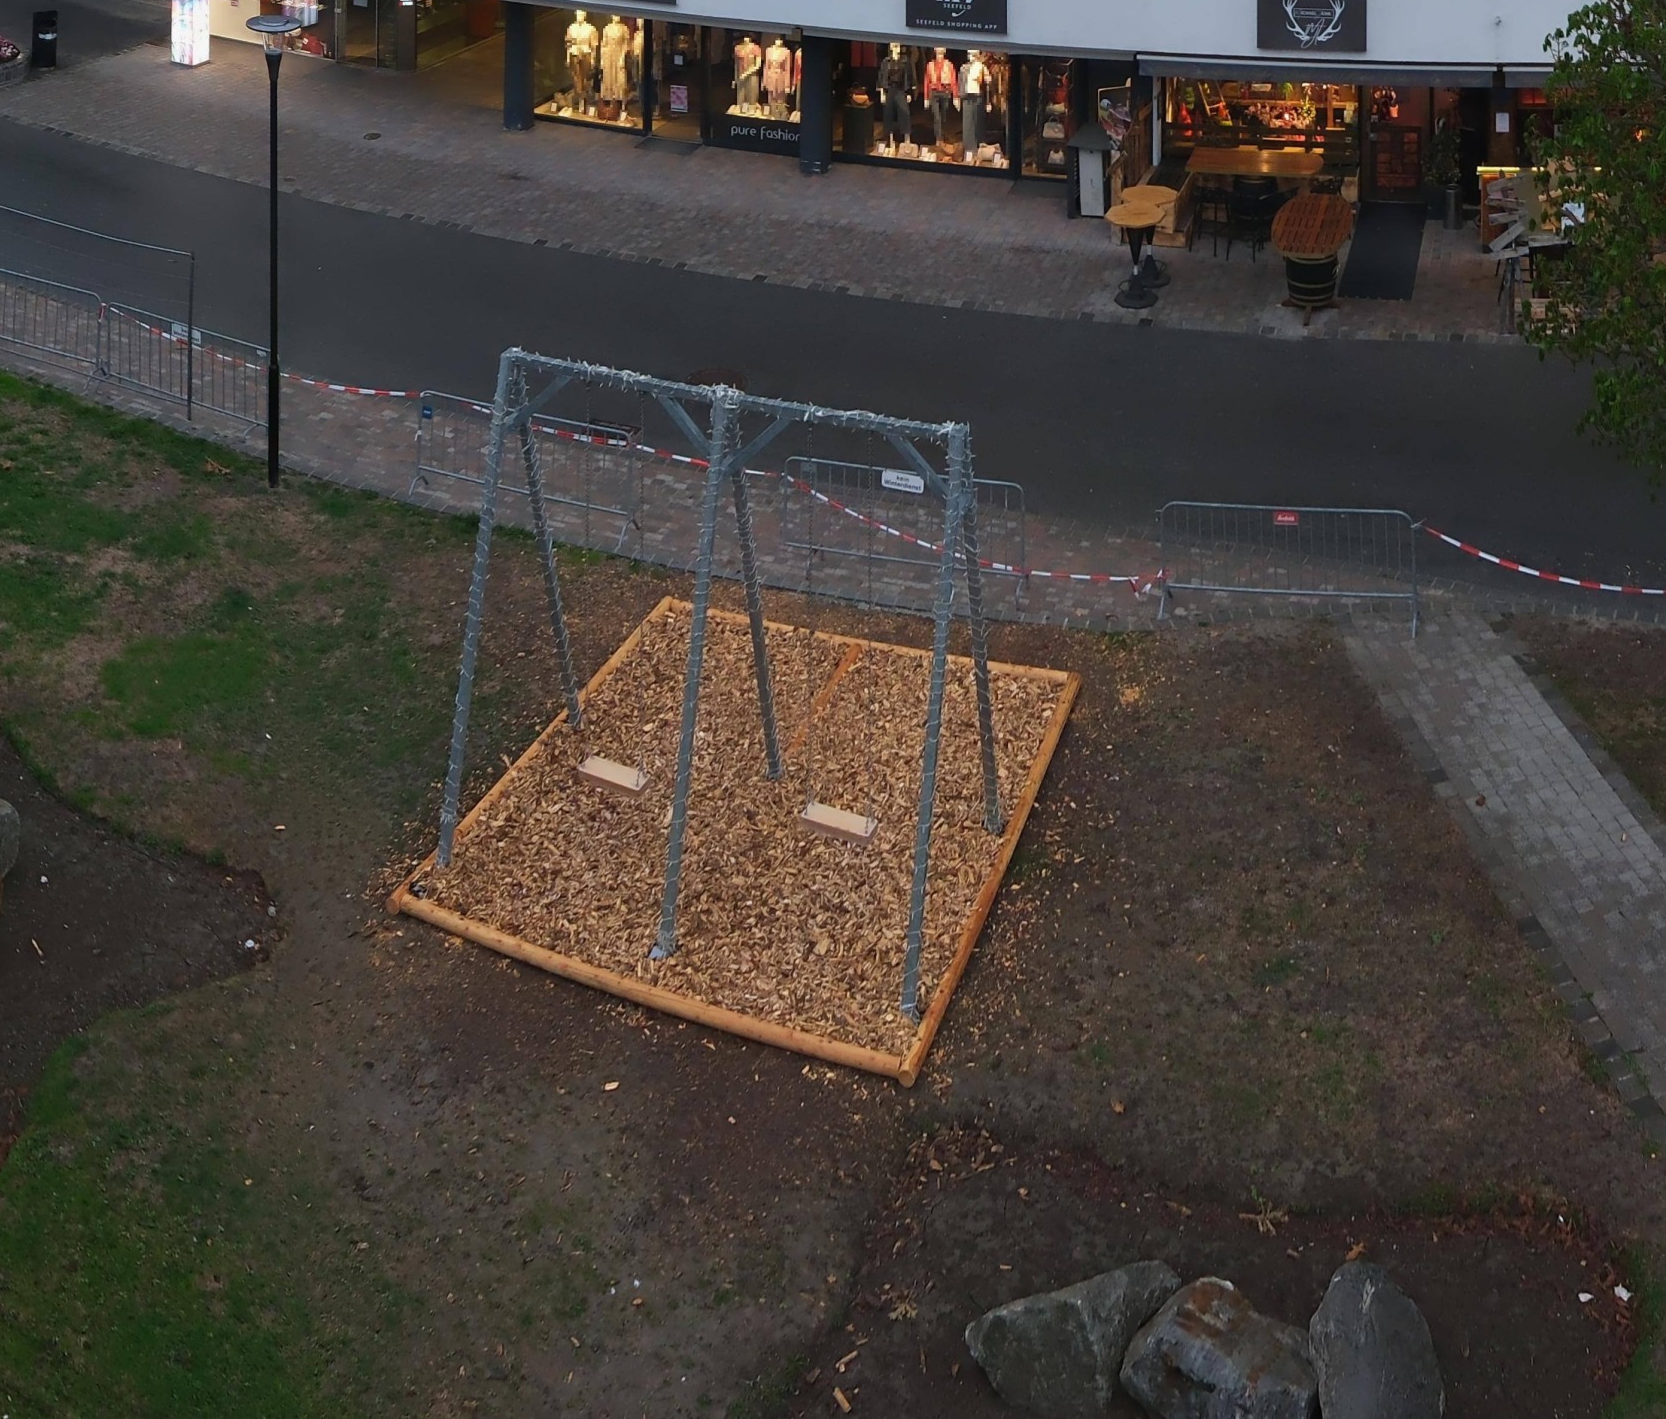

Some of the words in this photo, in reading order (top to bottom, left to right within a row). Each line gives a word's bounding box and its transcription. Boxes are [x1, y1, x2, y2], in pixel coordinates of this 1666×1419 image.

[943, 2, 972, 10] SEEFELD
[916, 18, 945, 26] SEEFELD
[947, 21, 982, 29] SHOPPING
[730, 125, 757, 137] pure
